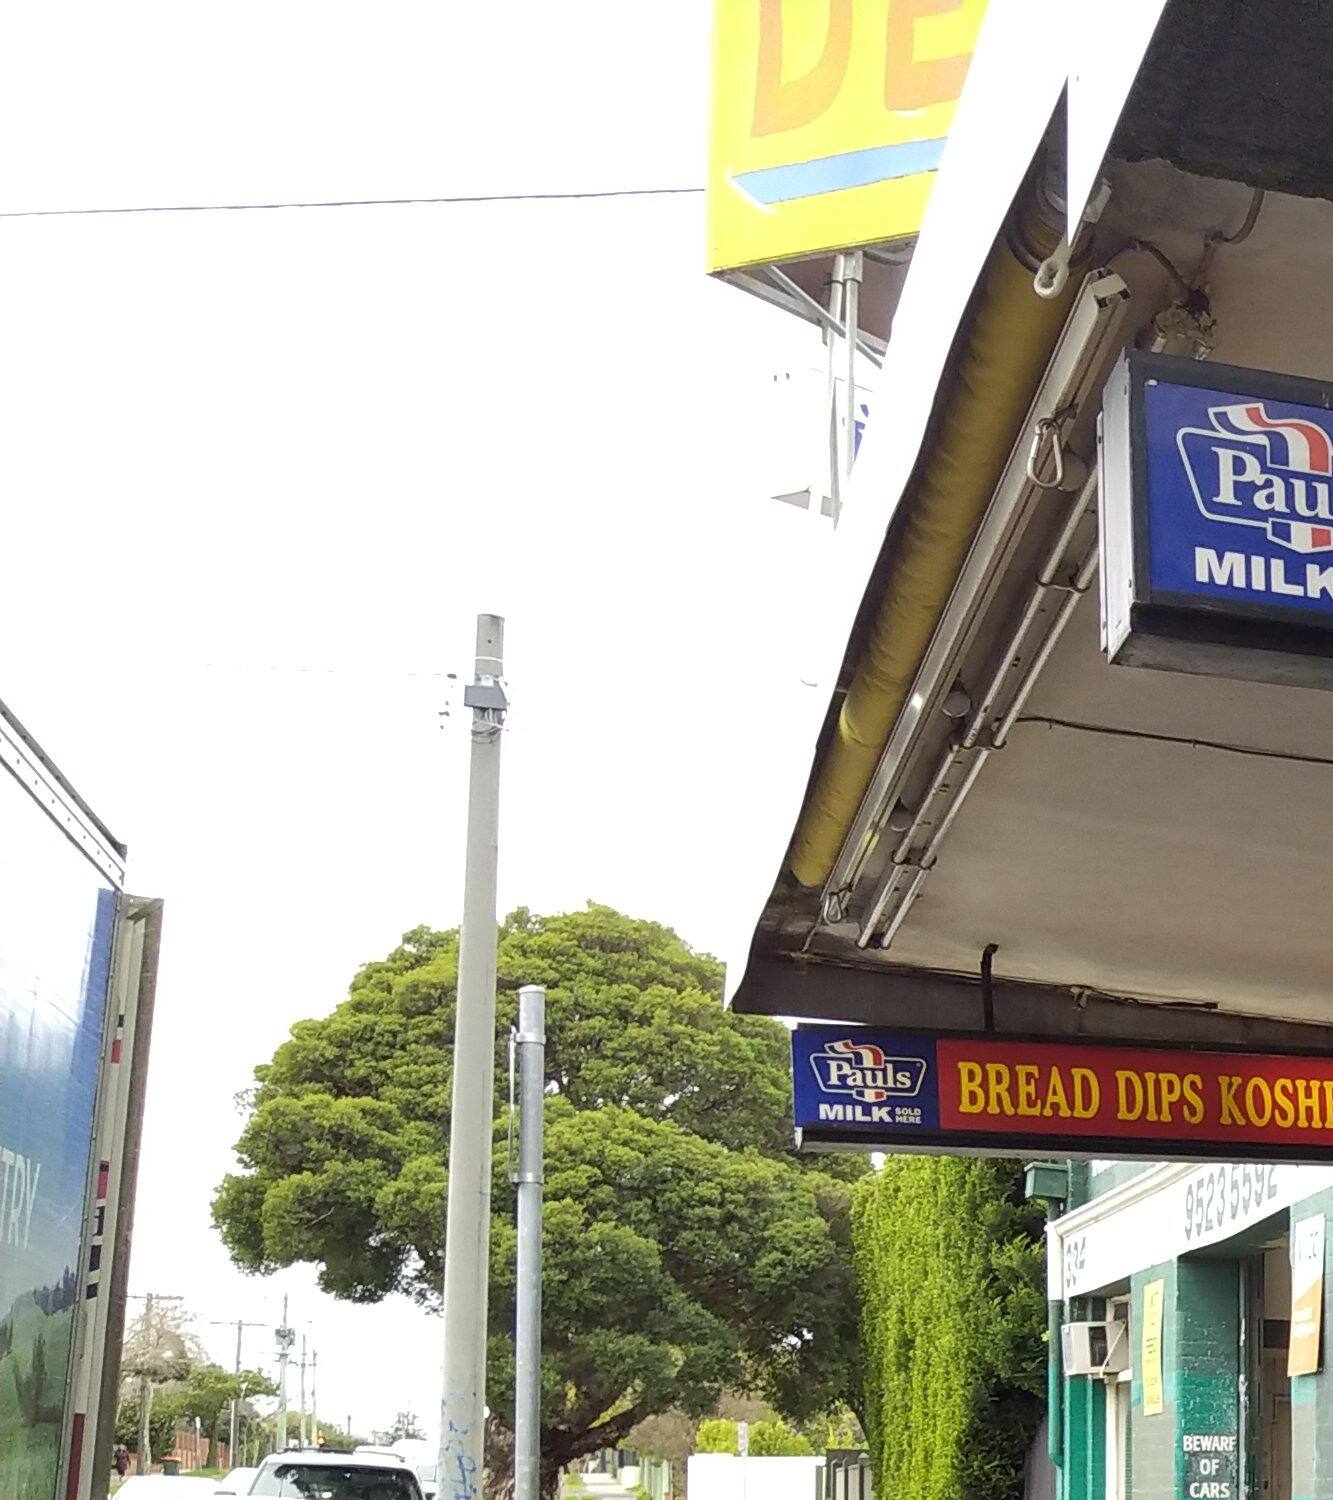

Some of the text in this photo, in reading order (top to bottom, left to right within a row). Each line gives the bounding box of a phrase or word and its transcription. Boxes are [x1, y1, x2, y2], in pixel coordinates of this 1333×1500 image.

[826, 1060, 912, 1088] Pauls
[958, 1061, 1100, 1119] BREAD
[1116, 1070, 1204, 1125] DIPS
[819, 1103, 893, 1122] MILK
[895, 1106, 921, 1116] SOLD
[895, 1115, 922, 1124] HERE
[1184, 1435, 1236, 1451] BEWARE
[1200, 1459, 1219, 1475] OF
[1189, 1482, 1230, 1498] CARS
